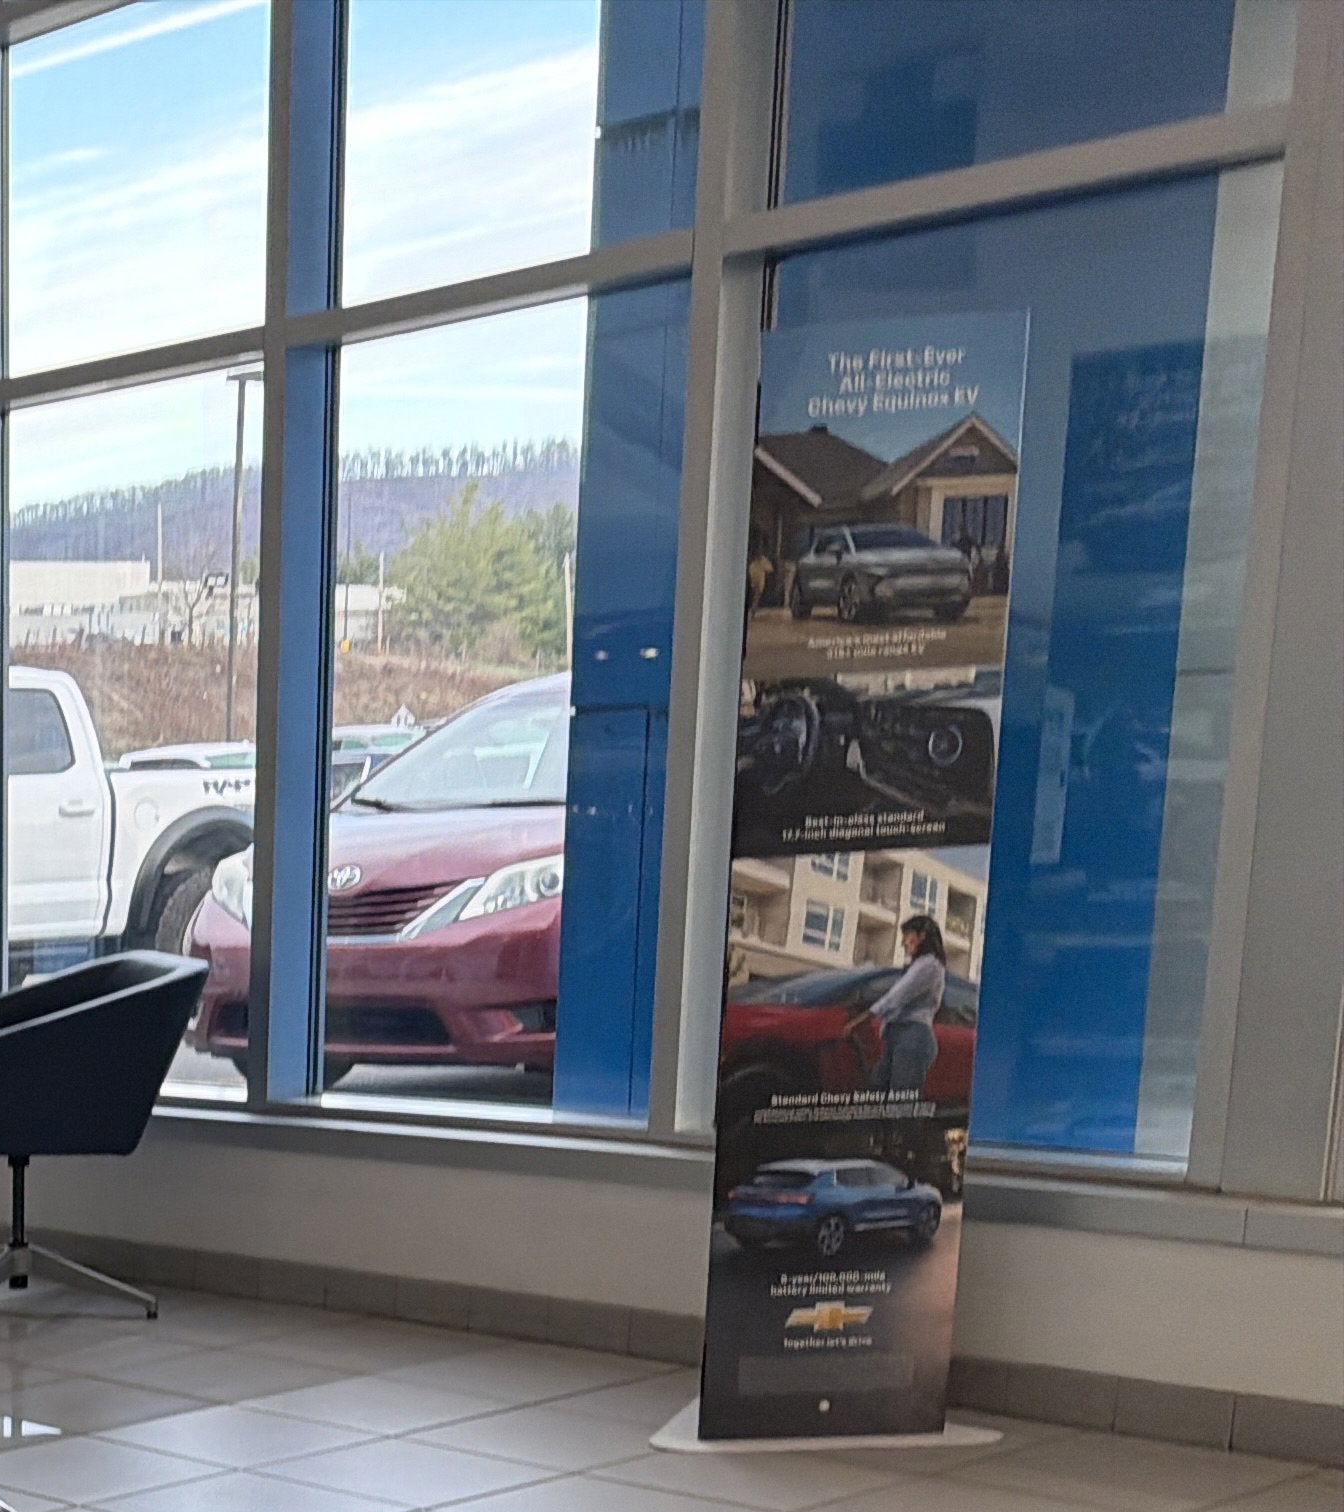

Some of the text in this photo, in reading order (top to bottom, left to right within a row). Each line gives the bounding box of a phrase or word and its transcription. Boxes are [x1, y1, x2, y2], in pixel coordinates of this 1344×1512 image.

[828, 351, 863, 374] The
[808, 384, 979, 418] Chevy Equinox EV
[877, 809, 924, 824] standard
[829, 825, 874, 841] diagonal
[771, 1088, 920, 1107] Standard Chevy Safety Assist
[770, 1280, 892, 1298] battery limited warranty
